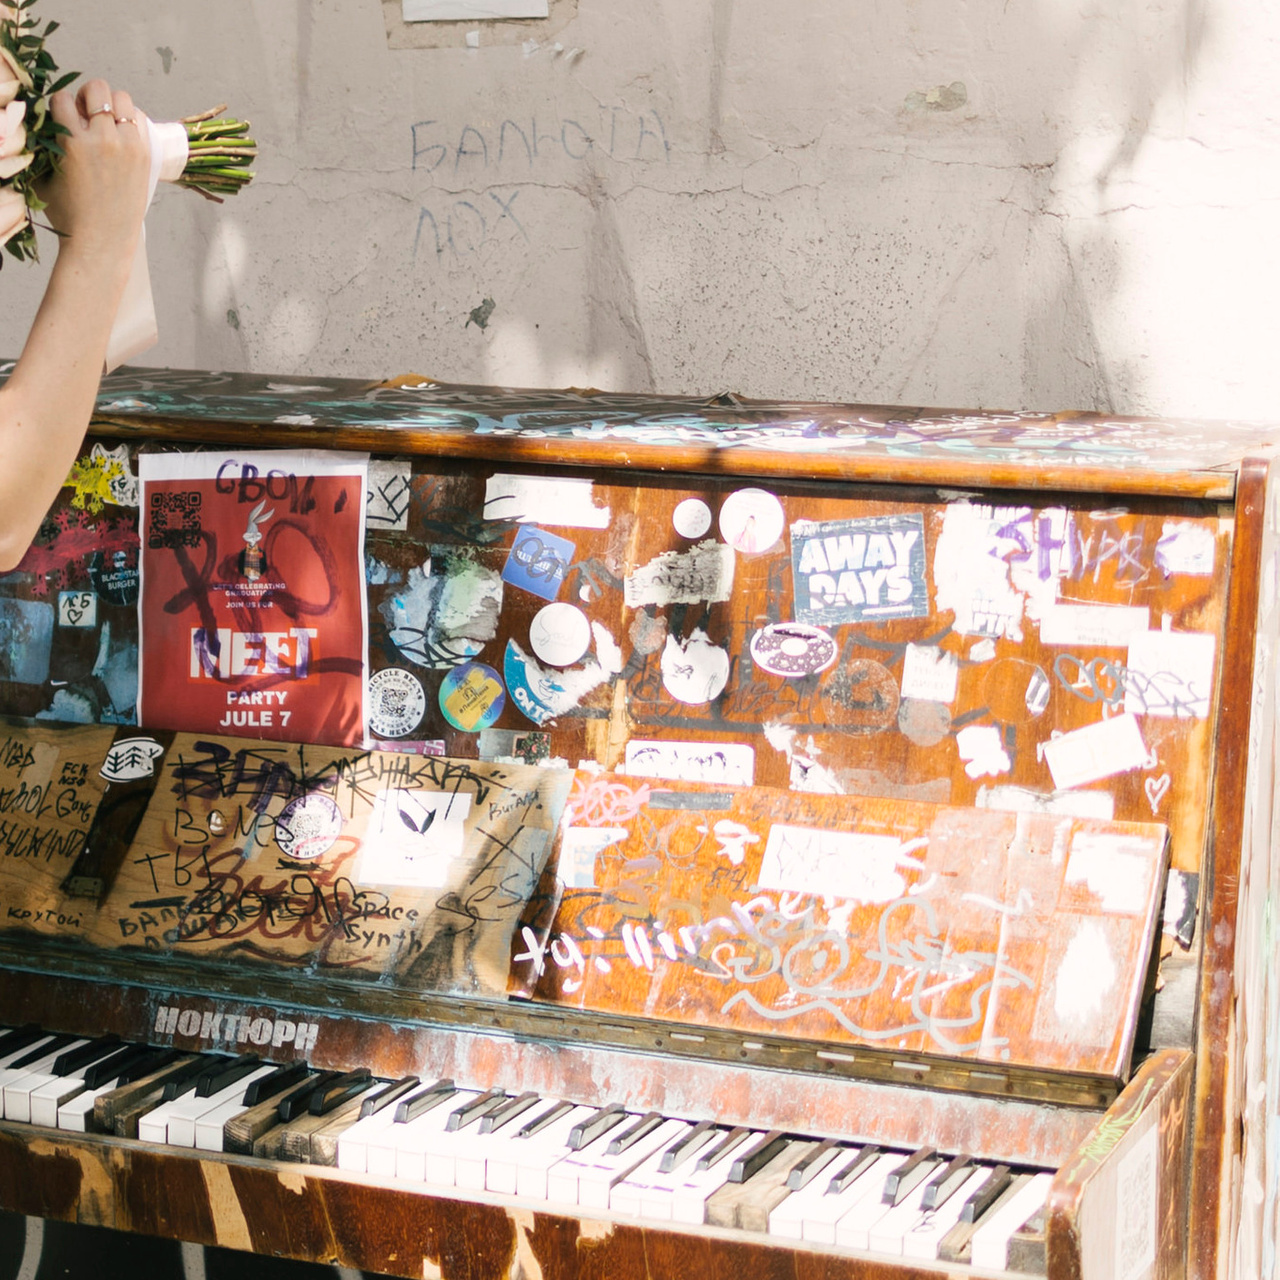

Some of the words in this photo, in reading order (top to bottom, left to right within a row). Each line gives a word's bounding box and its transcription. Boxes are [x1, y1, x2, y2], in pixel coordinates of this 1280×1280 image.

[412, 190, 530, 265] ЛОХ
[798, 530, 919, 573] AWAY
[108, 578, 136, 591] BURGER
[235, 582, 286, 591] CELEBRATING
[809, 565, 913, 610] DAYS
[225, 601, 244, 609] JOIN
[190, 627, 318, 679] MEET
[227, 691, 288, 705] PARTY
[220, 710, 273, 727] JULE
[279, 711, 292, 727] 7
[389, 723, 414, 736] HERE
[154, 1005, 319, 1050] НОКТЮРН
